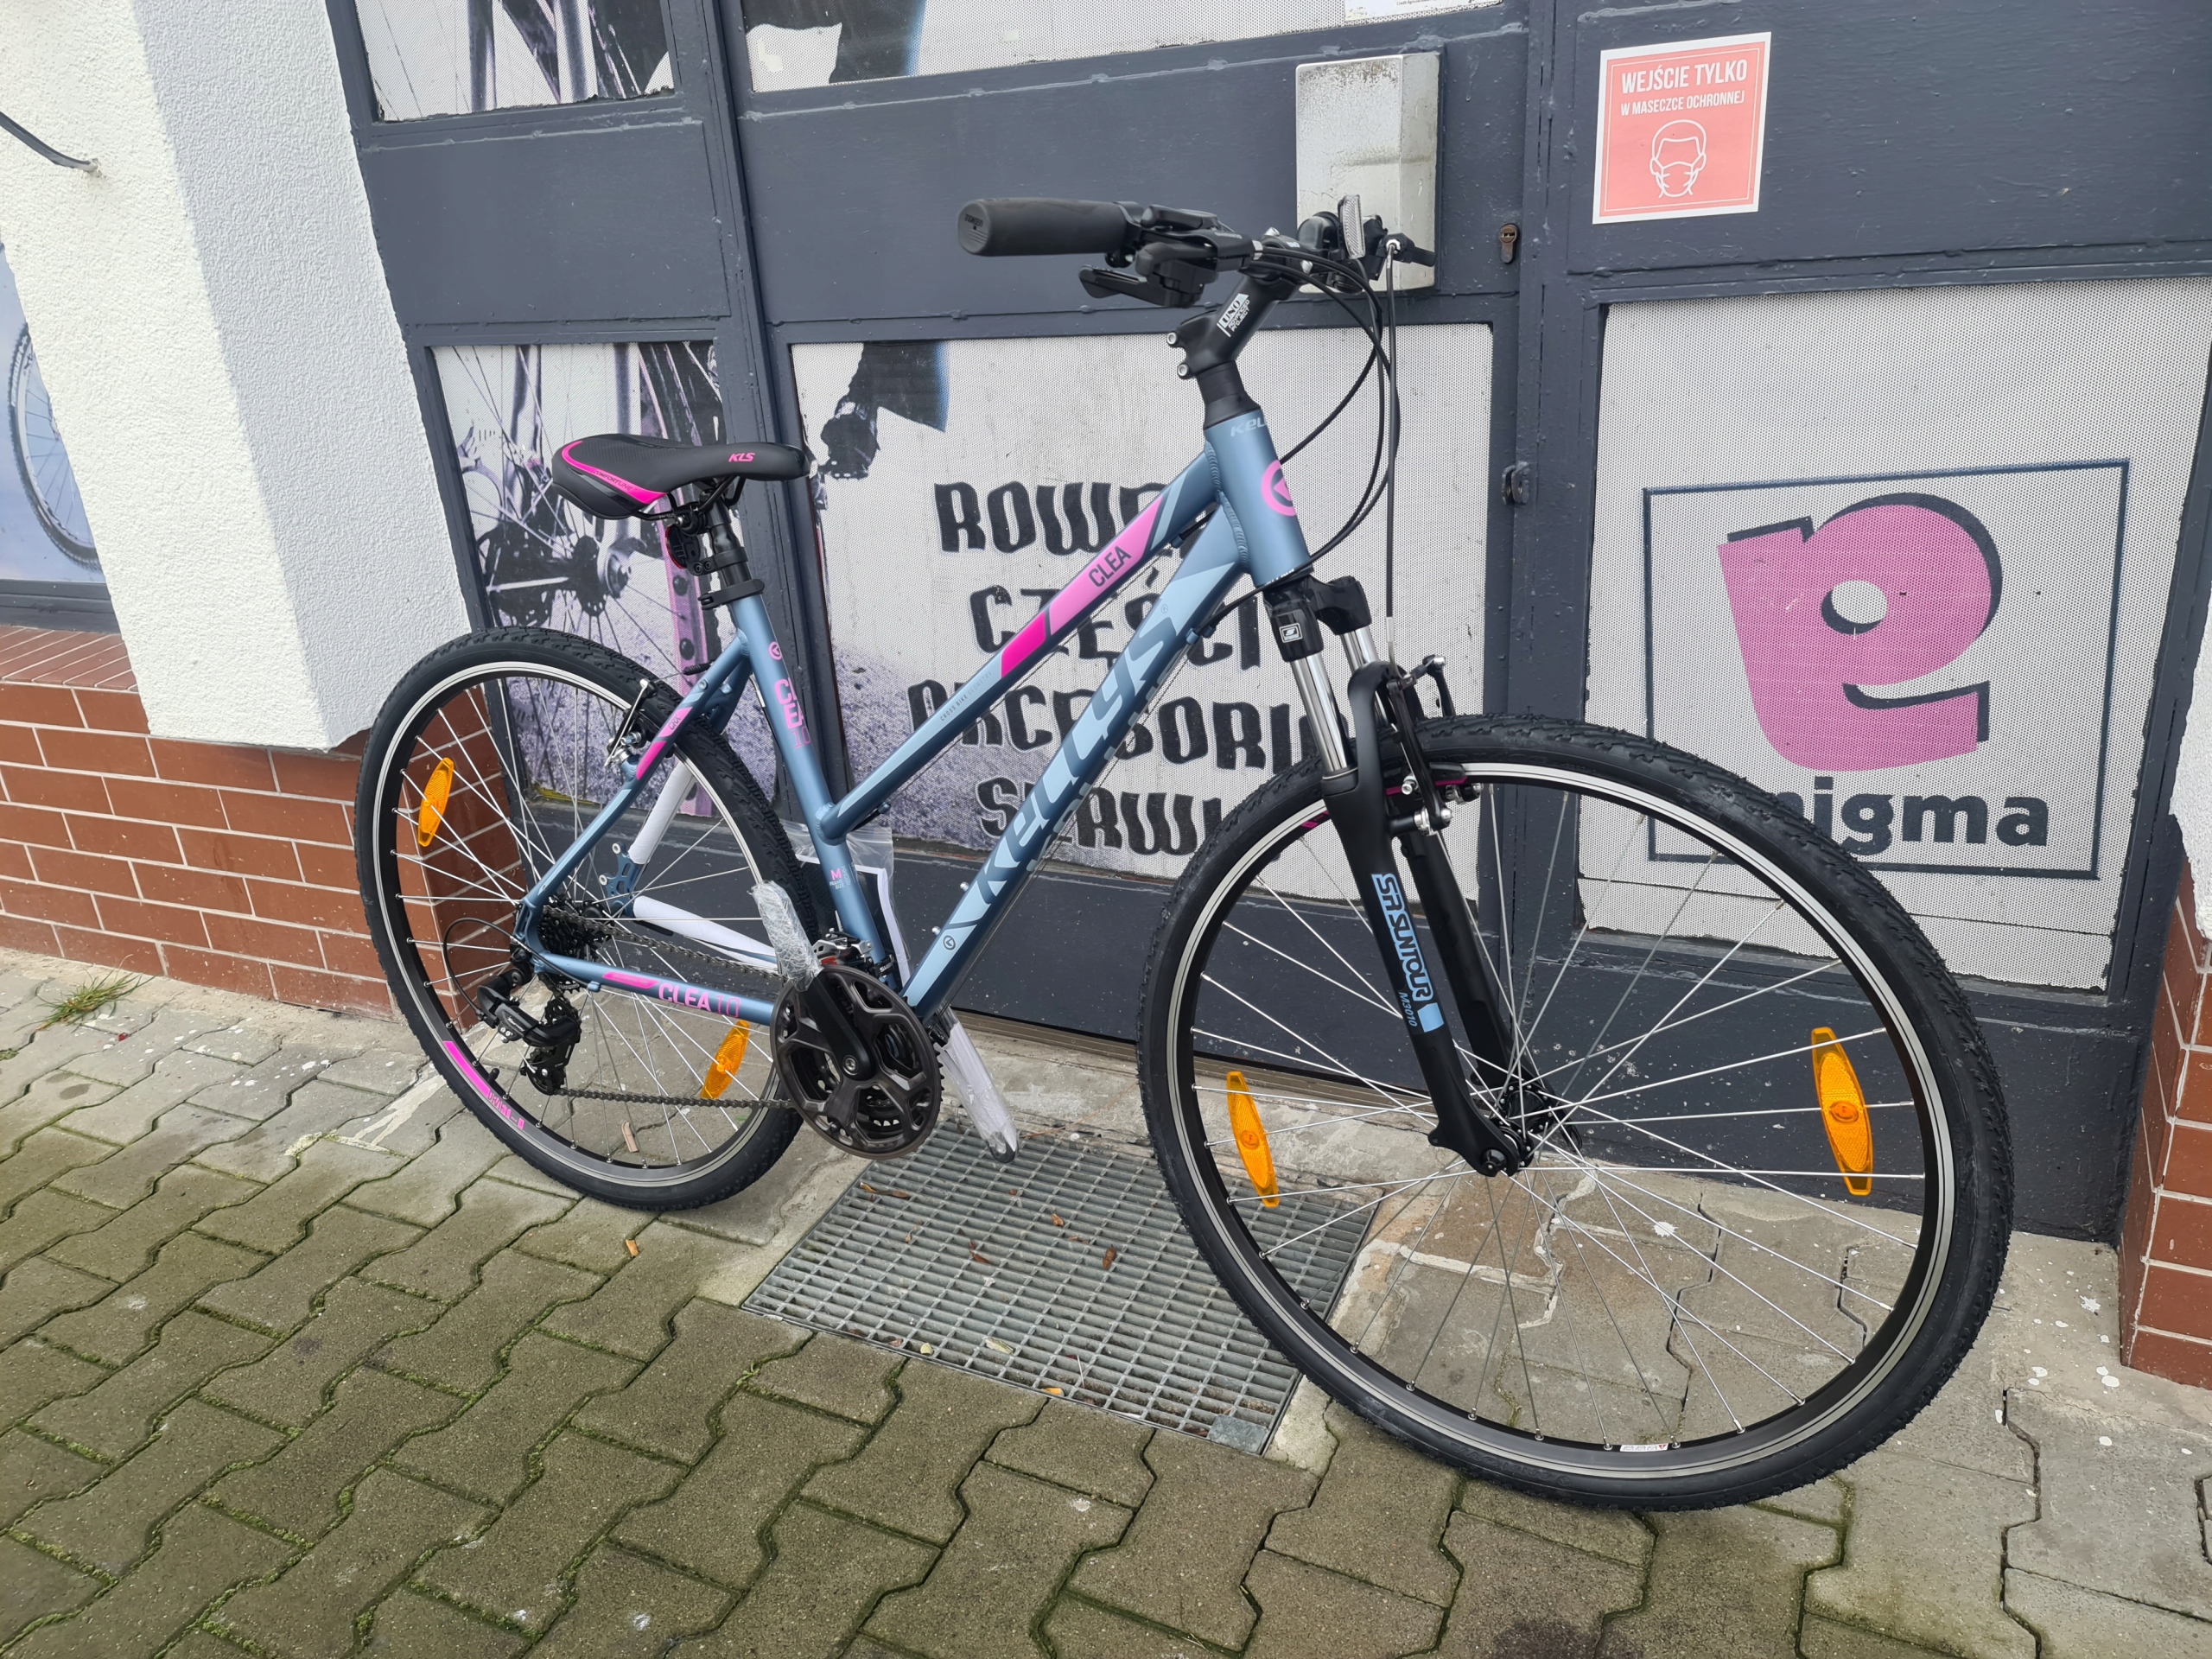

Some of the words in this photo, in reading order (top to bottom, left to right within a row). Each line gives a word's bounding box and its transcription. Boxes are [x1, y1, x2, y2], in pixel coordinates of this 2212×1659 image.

[1621, 65, 1690, 94] WEJŚCIE
[1694, 59, 1748, 86] TYLKO
[1621, 103, 1630, 117] W
[1631, 97, 1685, 115] MASECZCE
[1686, 90, 1745, 110] OCHRONNEJ
[1221, 300, 1242, 327] UNO
[728, 452, 756, 463] KLS
[1088, 545, 1132, 587] CLEA
[940, 705, 957, 721] CROSS
[956, 694, 968, 707] BIKE
[977, 778, 1222, 855] SRWI
[830, 868, 842, 880] M
[658, 982, 712, 1012] CLEA
[715, 995, 741, 1018] 10
[1398, 991, 1418, 1027] M3010
